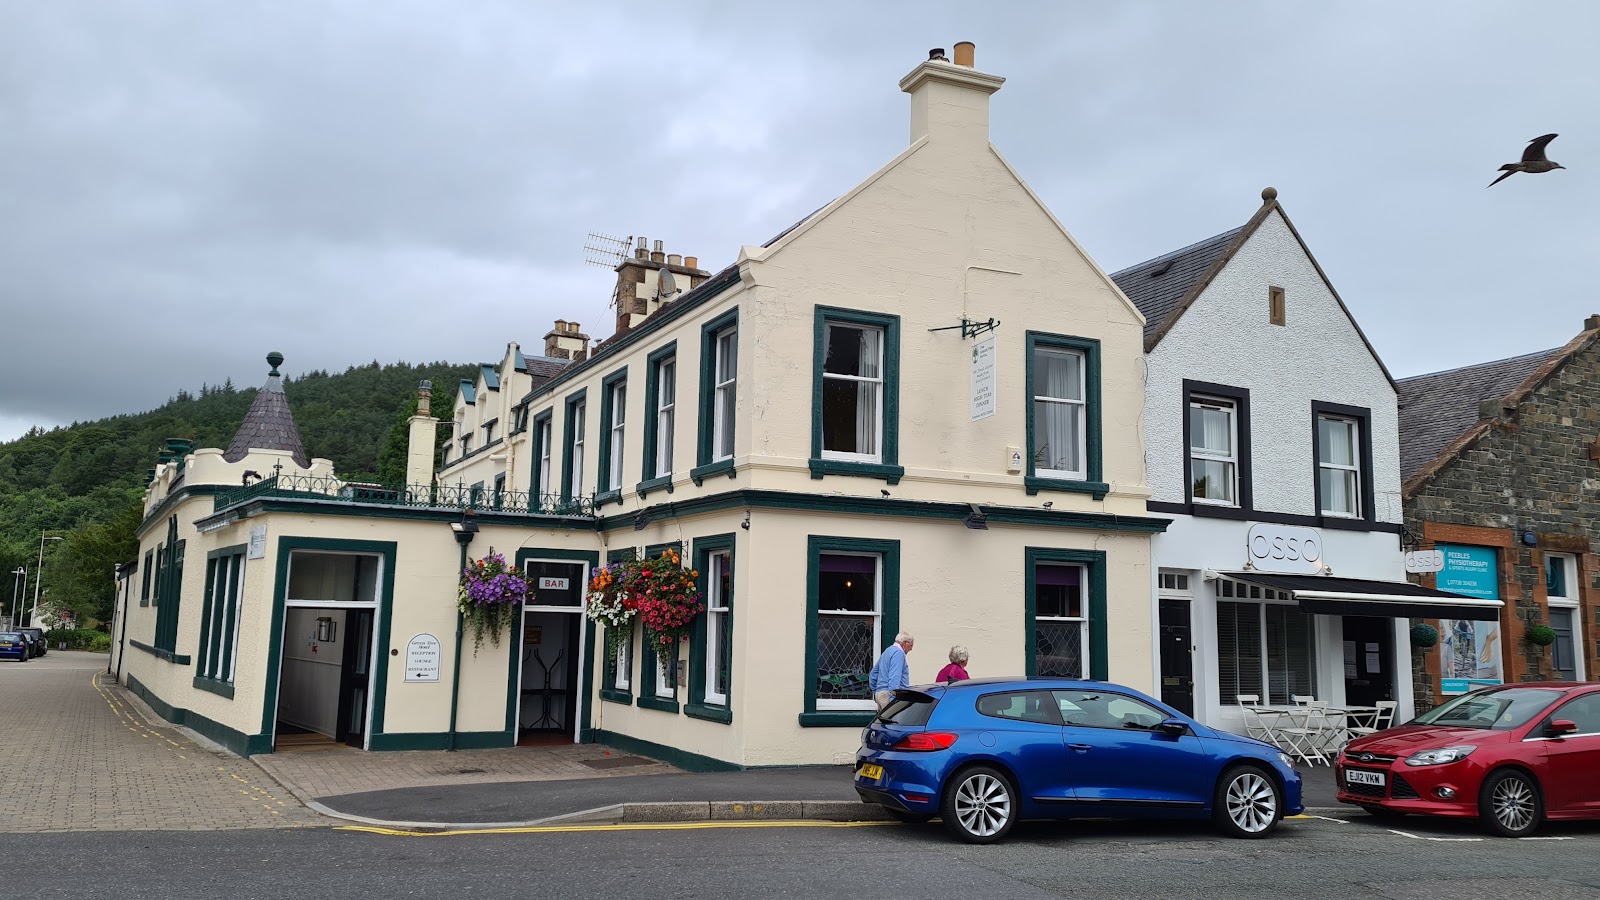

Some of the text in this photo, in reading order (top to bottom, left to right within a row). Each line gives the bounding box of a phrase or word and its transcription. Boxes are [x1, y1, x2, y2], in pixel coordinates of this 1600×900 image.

[1250, 533, 1321, 563] OSSO
[1448, 552, 1470, 560] PEEBLES
[1407, 556, 1442, 568] OSSO
[1448, 559, 1488, 568] PHYSIOTHERAPY
[1350, 771, 1364, 782] EJ12
